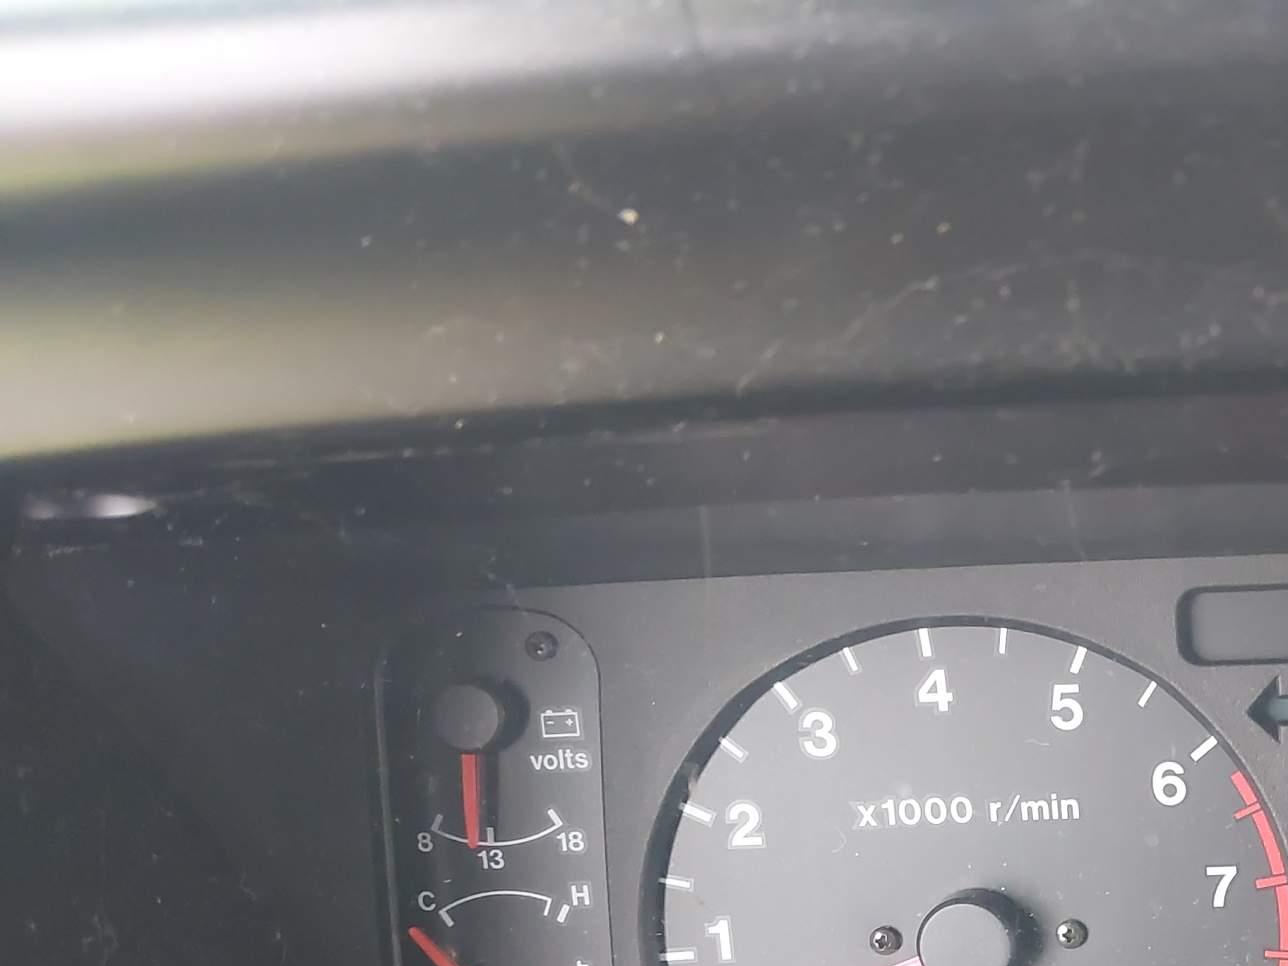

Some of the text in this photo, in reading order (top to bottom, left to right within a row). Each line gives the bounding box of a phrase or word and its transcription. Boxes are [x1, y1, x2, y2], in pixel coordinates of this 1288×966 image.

[918, 669, 954, 712] 4
[1050, 683, 1084, 731] 5
[801, 711, 838, 758] 3
[530, 748, 589, 770] volts
[1152, 761, 1187, 806] 6
[728, 802, 763, 847] 2
[856, 793, 1080, 827] x1000 r/min
[416, 830, 434, 852] 8
[477, 849, 505, 869] 13
[556, 831, 585, 852] 18
[418, 891, 436, 911] C
[570, 885, 590, 906] H
[1206, 865, 1237, 908] 7
[707, 919, 732, 961] 1
